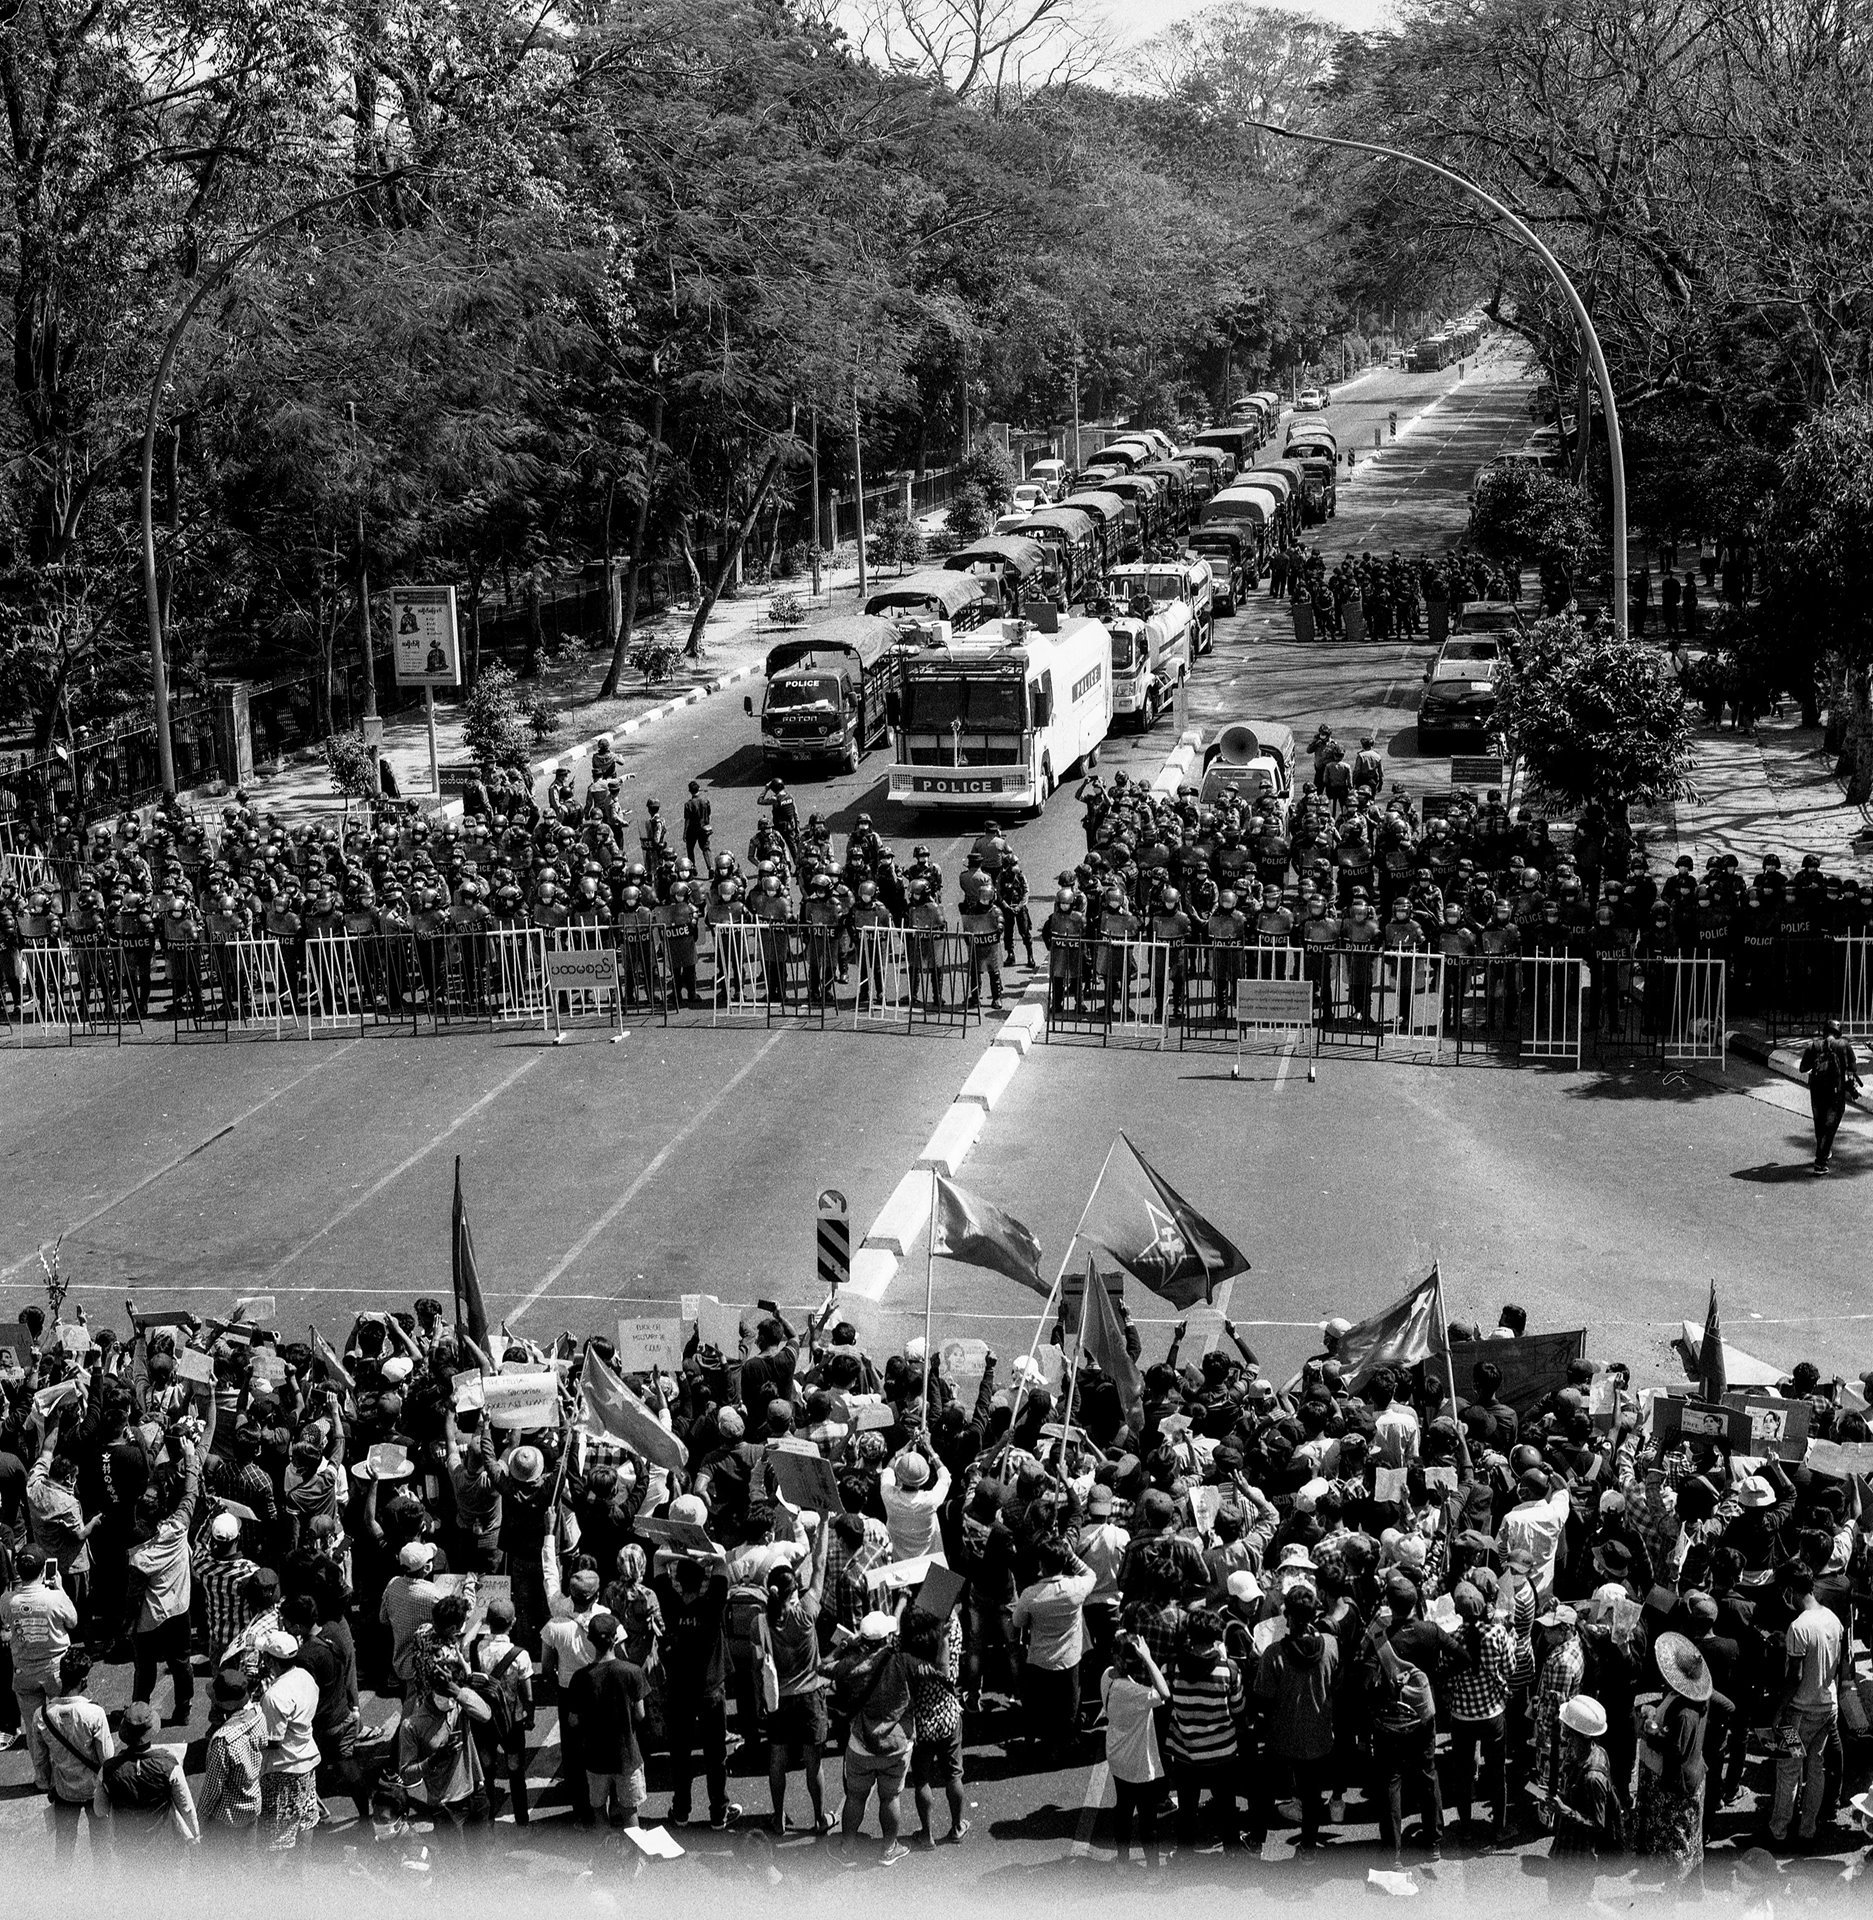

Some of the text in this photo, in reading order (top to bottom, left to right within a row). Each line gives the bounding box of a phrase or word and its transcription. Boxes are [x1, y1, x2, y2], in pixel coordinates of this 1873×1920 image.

[1077, 669, 1099, 698] POLICE
[923, 781, 992, 792] POLICE
[1262, 857, 1287, 865] POLICE
[1343, 866, 1368, 876] POLICE
[1391, 868, 1415, 879] POLICE
[1514, 912, 1542, 923] POLICE
[661, 926, 689, 937] OLICE
[1569, 926, 1585, 934] ICE
[1781, 921, 1810, 932] POLICE
[544, 930, 559, 938] LIC
[625, 933, 650, 942] OLCE
[1700, 926, 1728, 940] POLICE
[120, 938, 150, 947] POLICE
[1596, 948, 1626, 958] POLICE
[551, 957, 614, 979] ပထမစည်း
